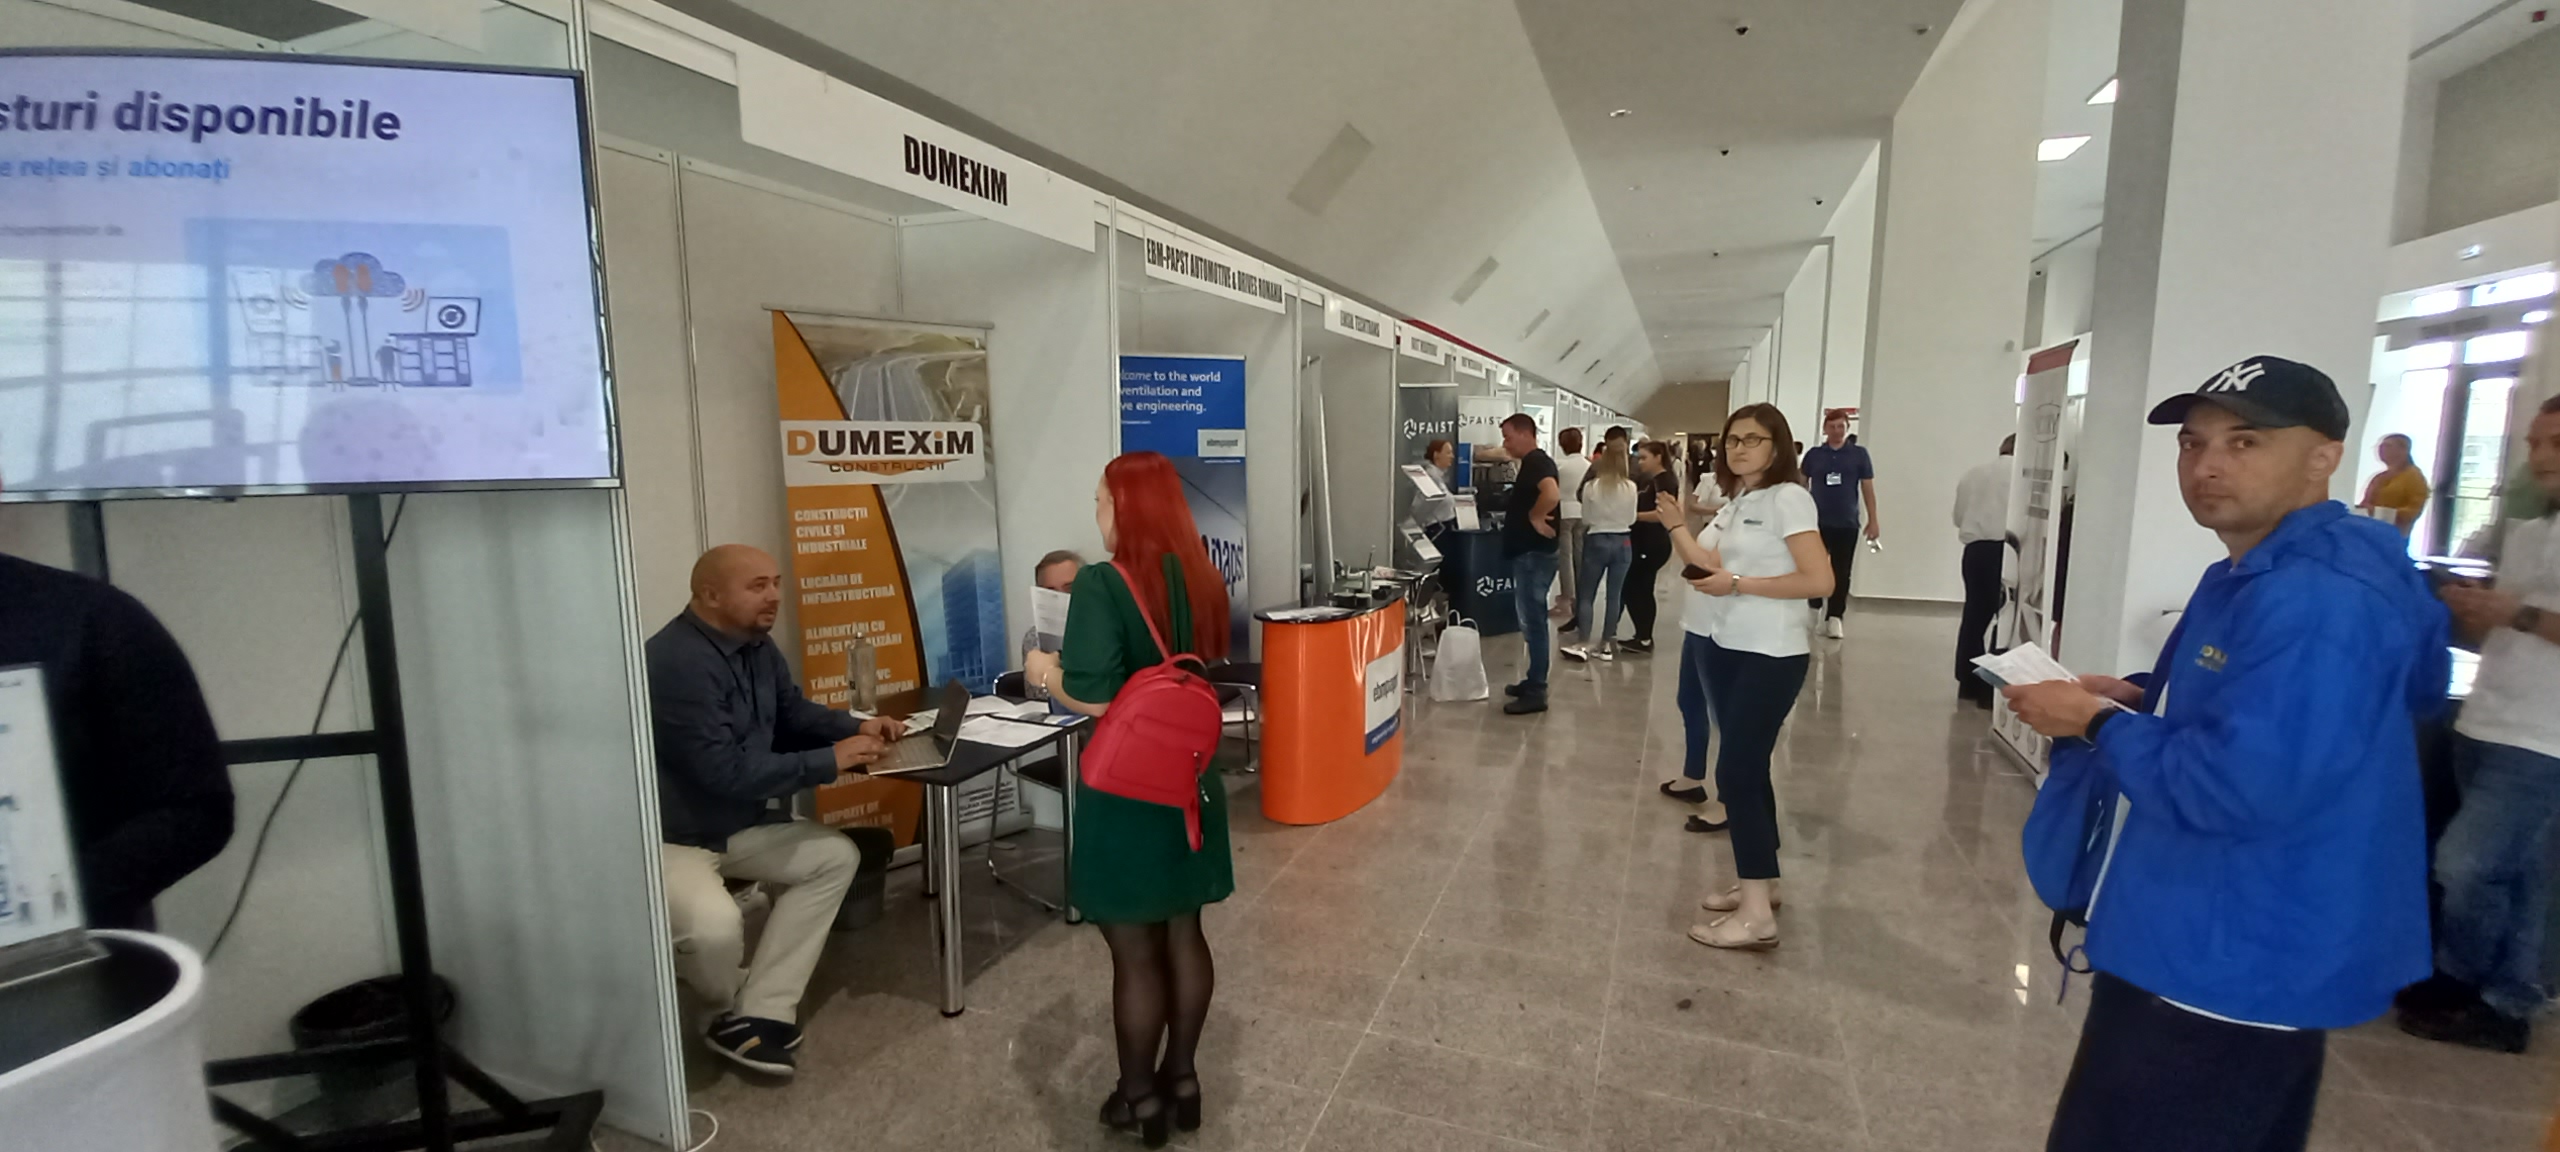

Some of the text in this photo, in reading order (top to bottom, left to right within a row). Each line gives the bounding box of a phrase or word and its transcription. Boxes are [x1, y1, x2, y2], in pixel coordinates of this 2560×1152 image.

[113, 90, 400, 143] disponibile
[904, 133, 1008, 206] DUMEXIM
[1147, 238, 1189, 275] EBM-PAPST
[1190, 254, 1231, 288] AUTOMOTIVE
[1232, 271, 1236, 290] &
[1237, 270, 1257, 296] DRIVES
[1154, 371, 1166, 381] to
[1169, 370, 1187, 381] the
[1189, 371, 1221, 382] world
[1120, 384, 1202, 397] ventilation and
[1120, 400, 1207, 414] ve engineering.
[1418, 421, 1454, 434] FAIST
[796, 524, 832, 538] CIVILE
[797, 538, 867, 554] INDUSTRIALE
[850, 573, 863, 585] DE
[1497, 577, 1517, 591] FAI
[870, 620, 885, 632] CU
